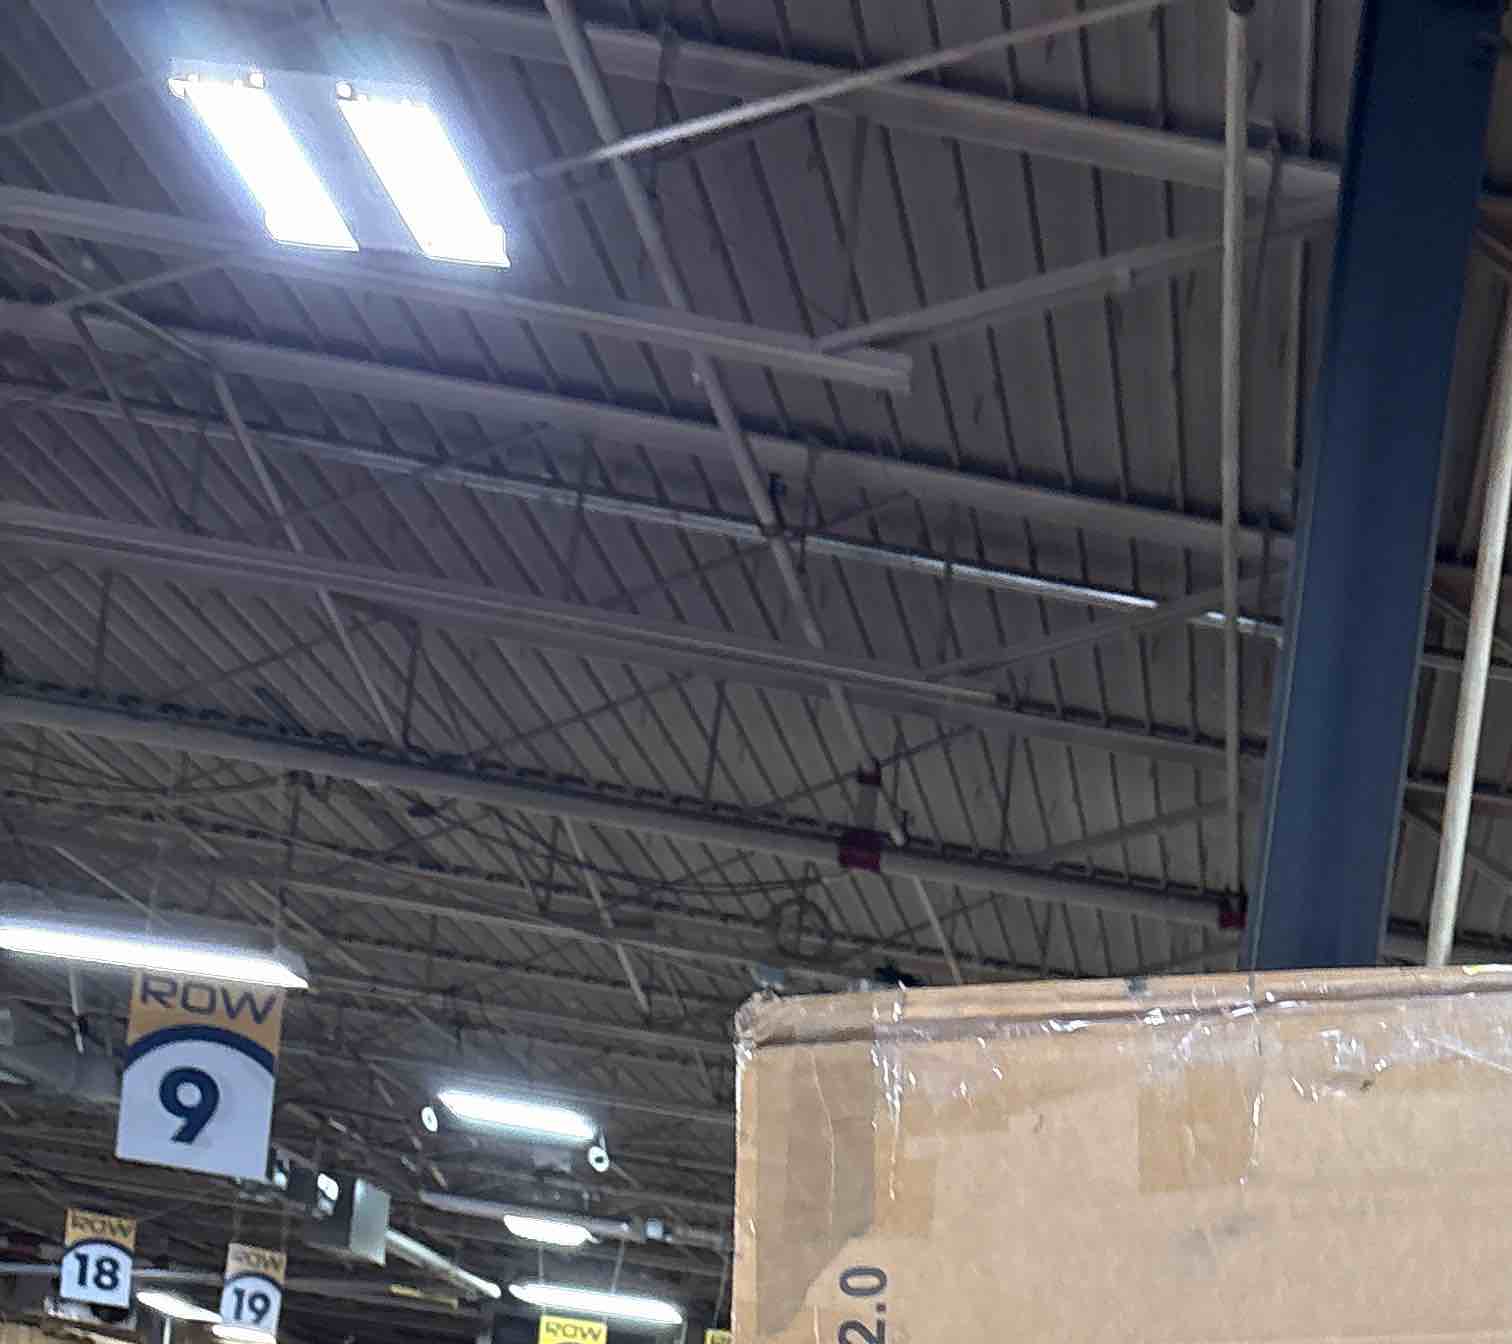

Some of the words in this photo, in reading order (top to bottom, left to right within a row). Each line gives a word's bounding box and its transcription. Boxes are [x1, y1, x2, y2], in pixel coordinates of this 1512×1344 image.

[141, 973, 277, 1024] ROW
[158, 1065, 221, 1145] 9
[71, 1214, 130, 1238] ROW
[73, 1250, 121, 1291] 18
[232, 1286, 272, 1325] 19
[545, 1320, 603, 1342] ROW
